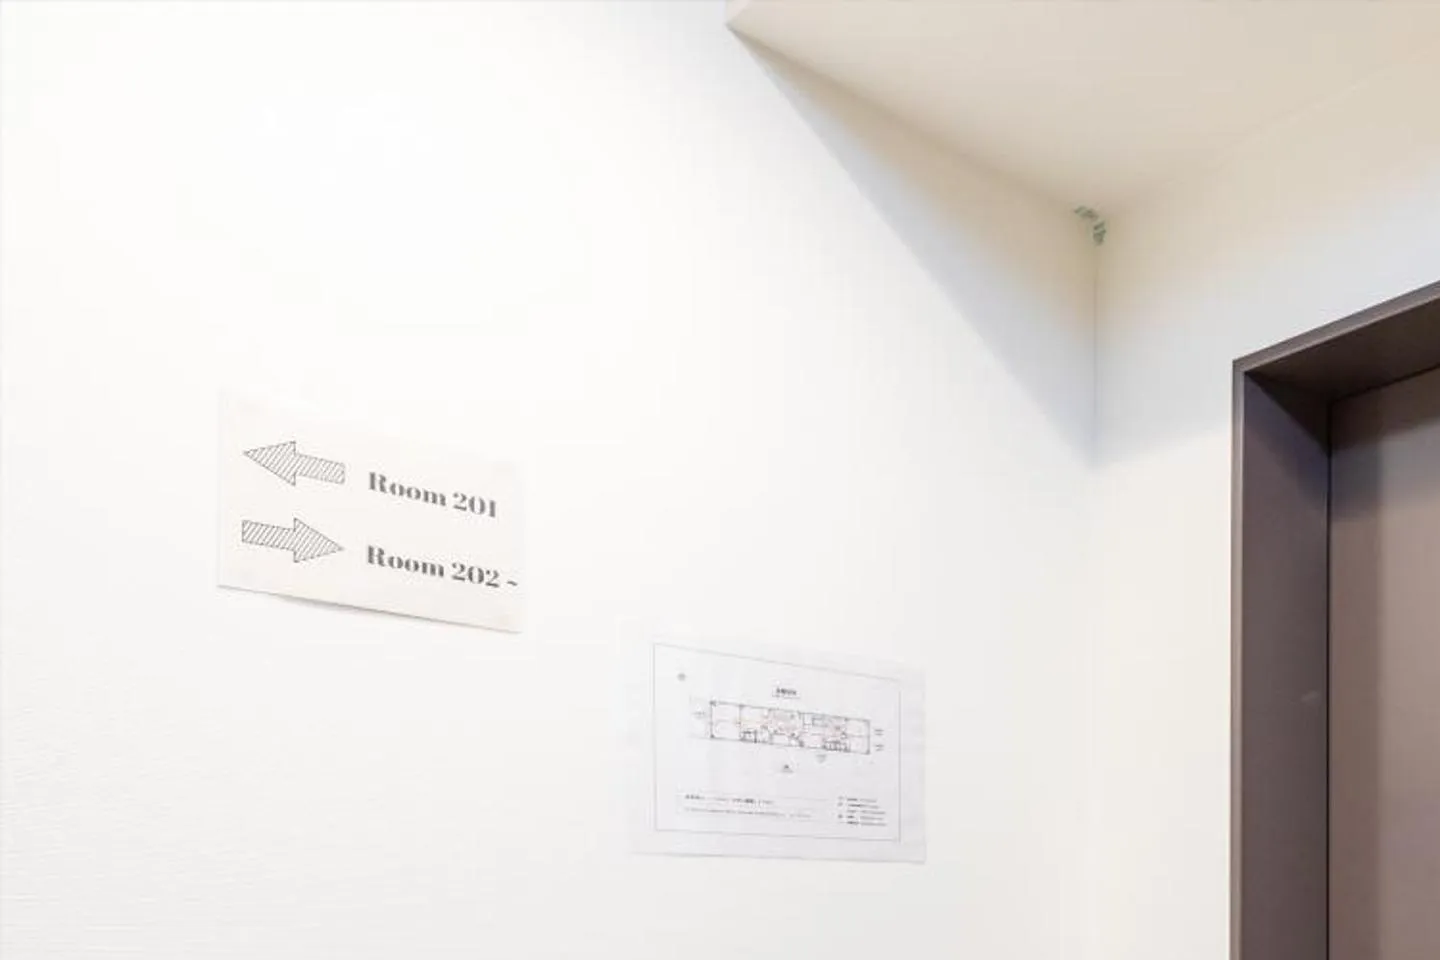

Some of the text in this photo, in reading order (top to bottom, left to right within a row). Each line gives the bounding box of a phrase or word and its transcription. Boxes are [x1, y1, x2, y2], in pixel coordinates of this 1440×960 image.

[368, 471, 497, 518] Room 201
[367, 545, 446, 578] Room
[451, 562, 501, 588] 202
